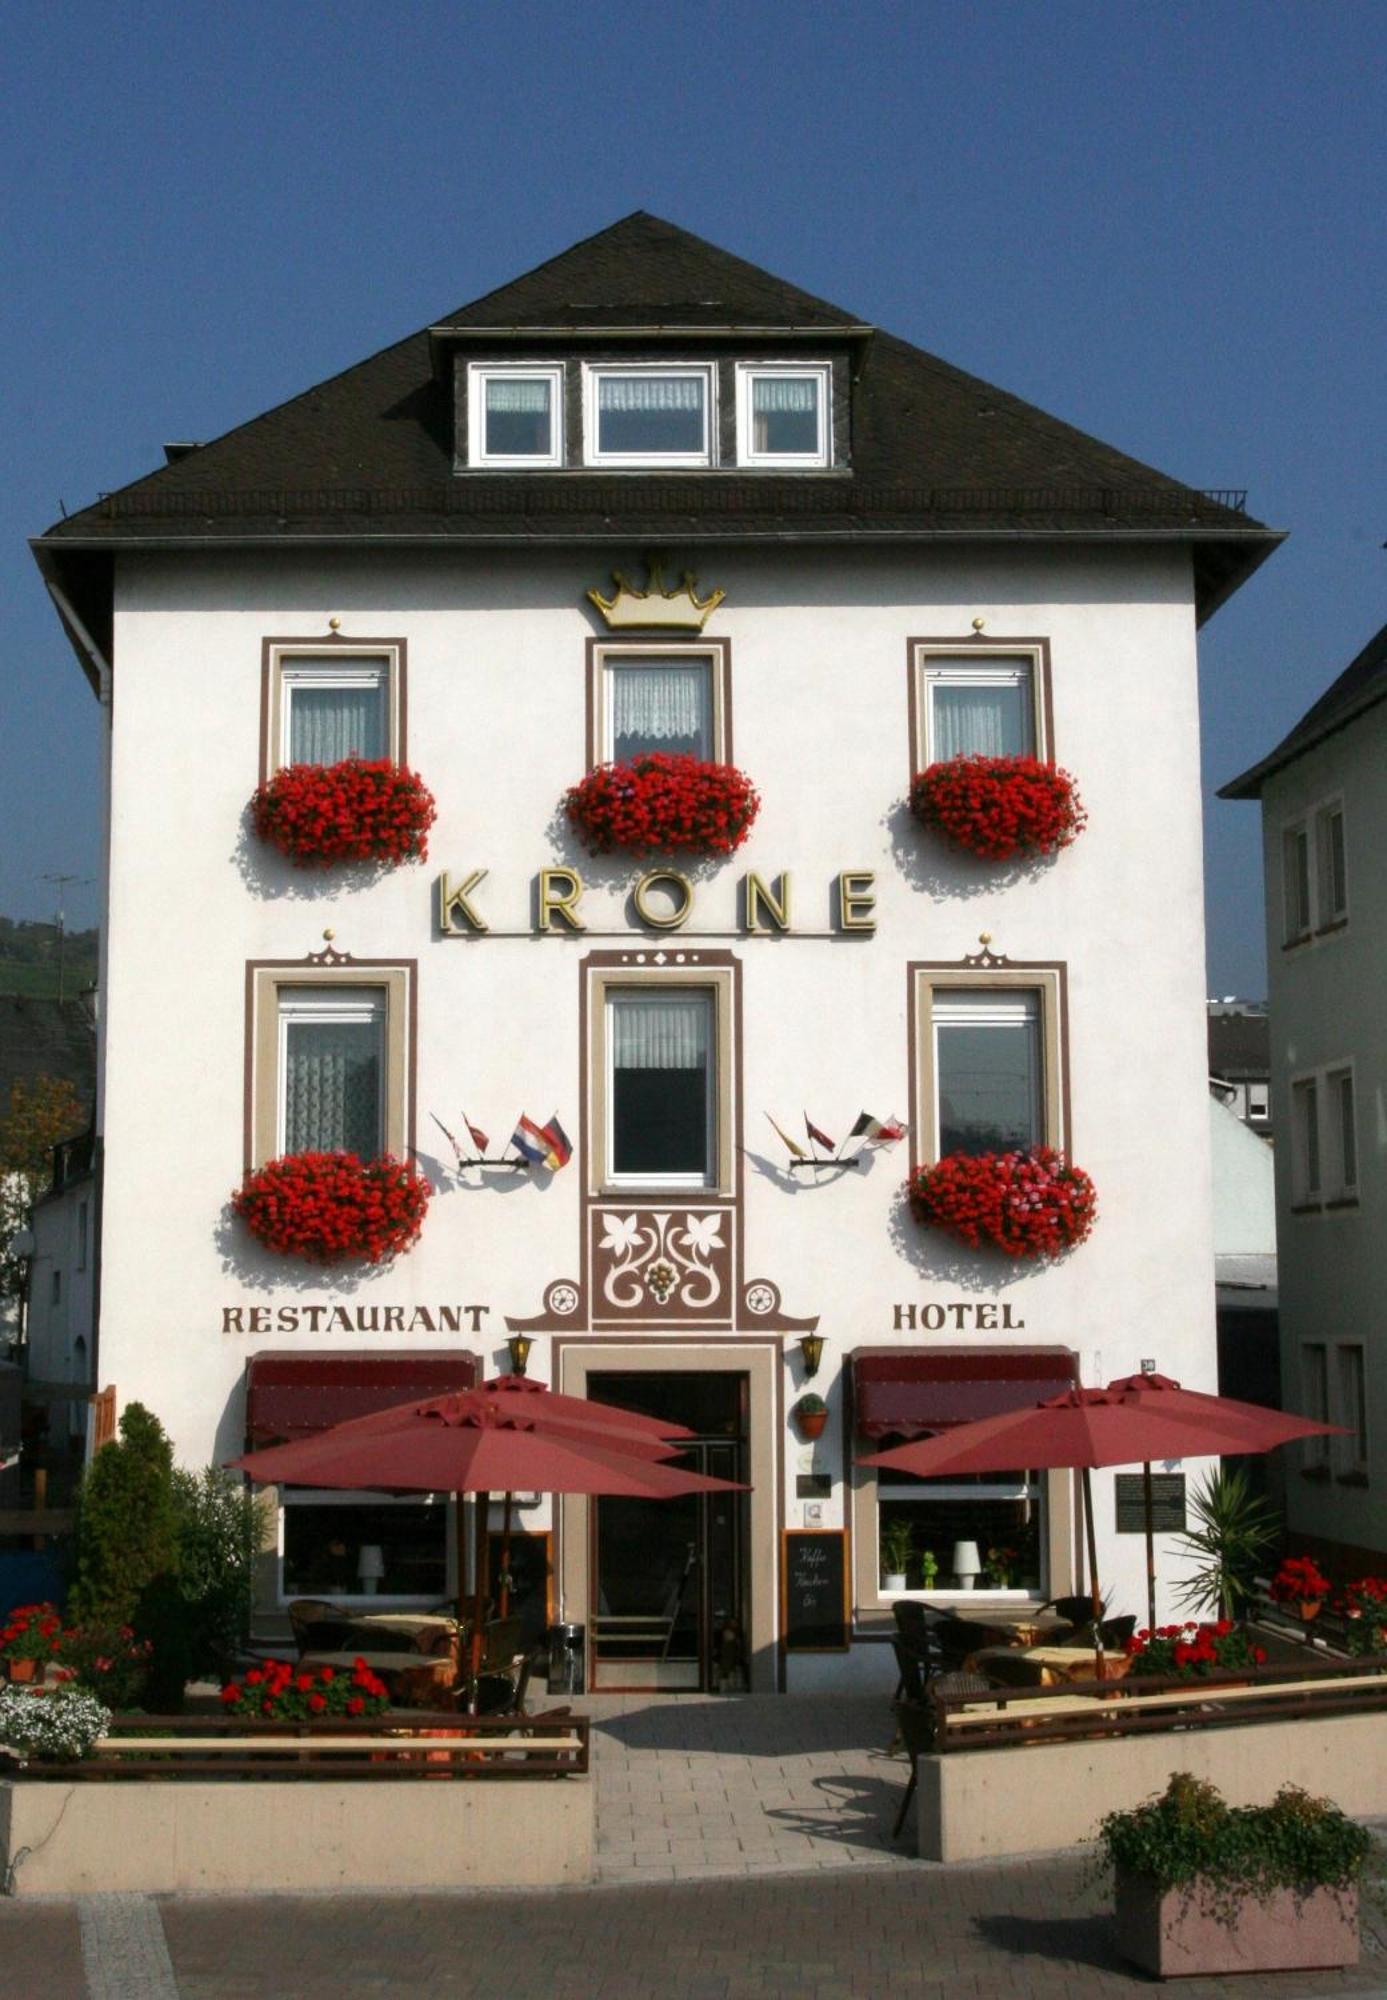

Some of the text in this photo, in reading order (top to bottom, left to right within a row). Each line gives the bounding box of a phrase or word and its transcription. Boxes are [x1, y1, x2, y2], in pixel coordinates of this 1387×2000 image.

[439, 866, 876, 931] KRONE
[222, 1305, 490, 1333] RESTAURANT
[893, 1303, 1025, 1330] HOTEL
